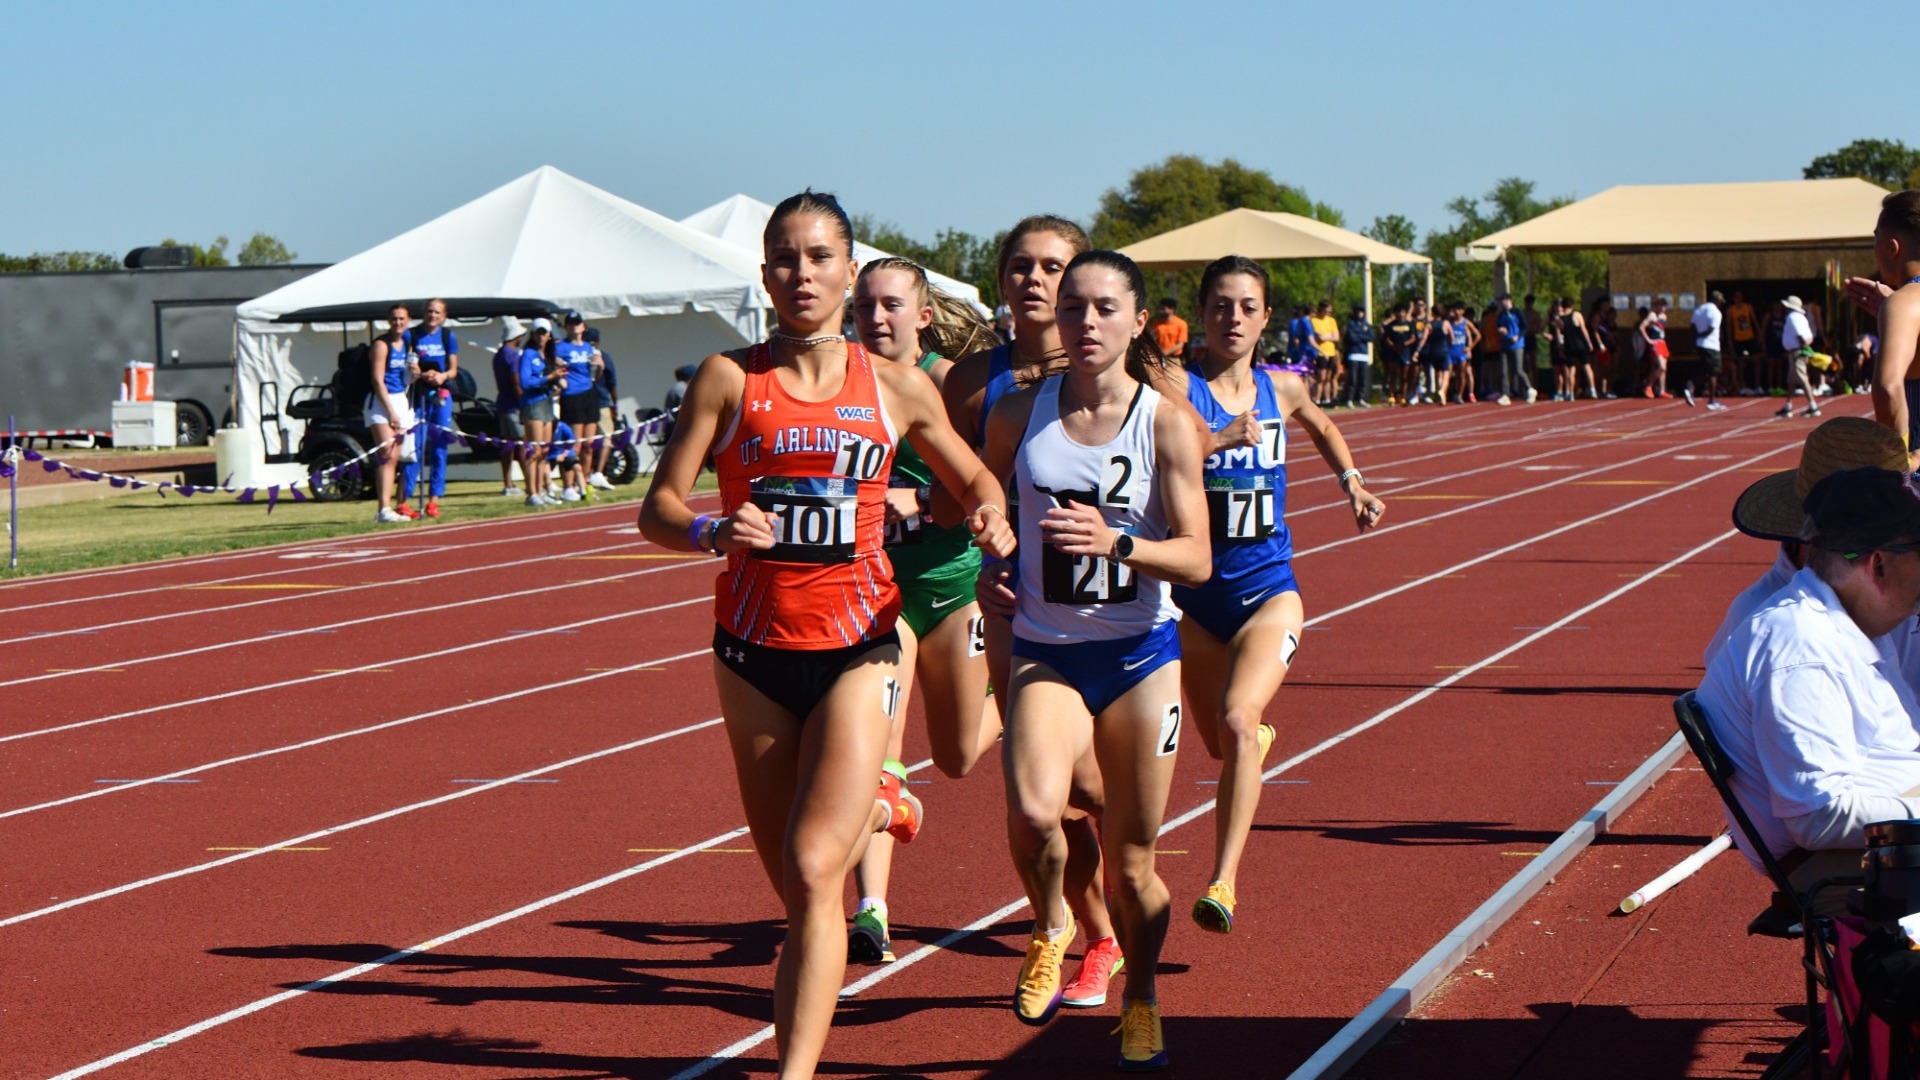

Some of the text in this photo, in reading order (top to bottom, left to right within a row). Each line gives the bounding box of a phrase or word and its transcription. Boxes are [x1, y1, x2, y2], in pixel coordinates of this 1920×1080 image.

[834, 406, 876, 422] WAC
[740, 435, 763, 466] UT
[843, 440, 885, 479] 10
[1263, 422, 1280, 461] 7
[1106, 455, 1132, 504] 2
[1209, 478, 1235, 487] NTX
[1233, 493, 1253, 537] 7
[1074, 552, 1099, 599] 2
[1163, 705, 1180, 754] 2
